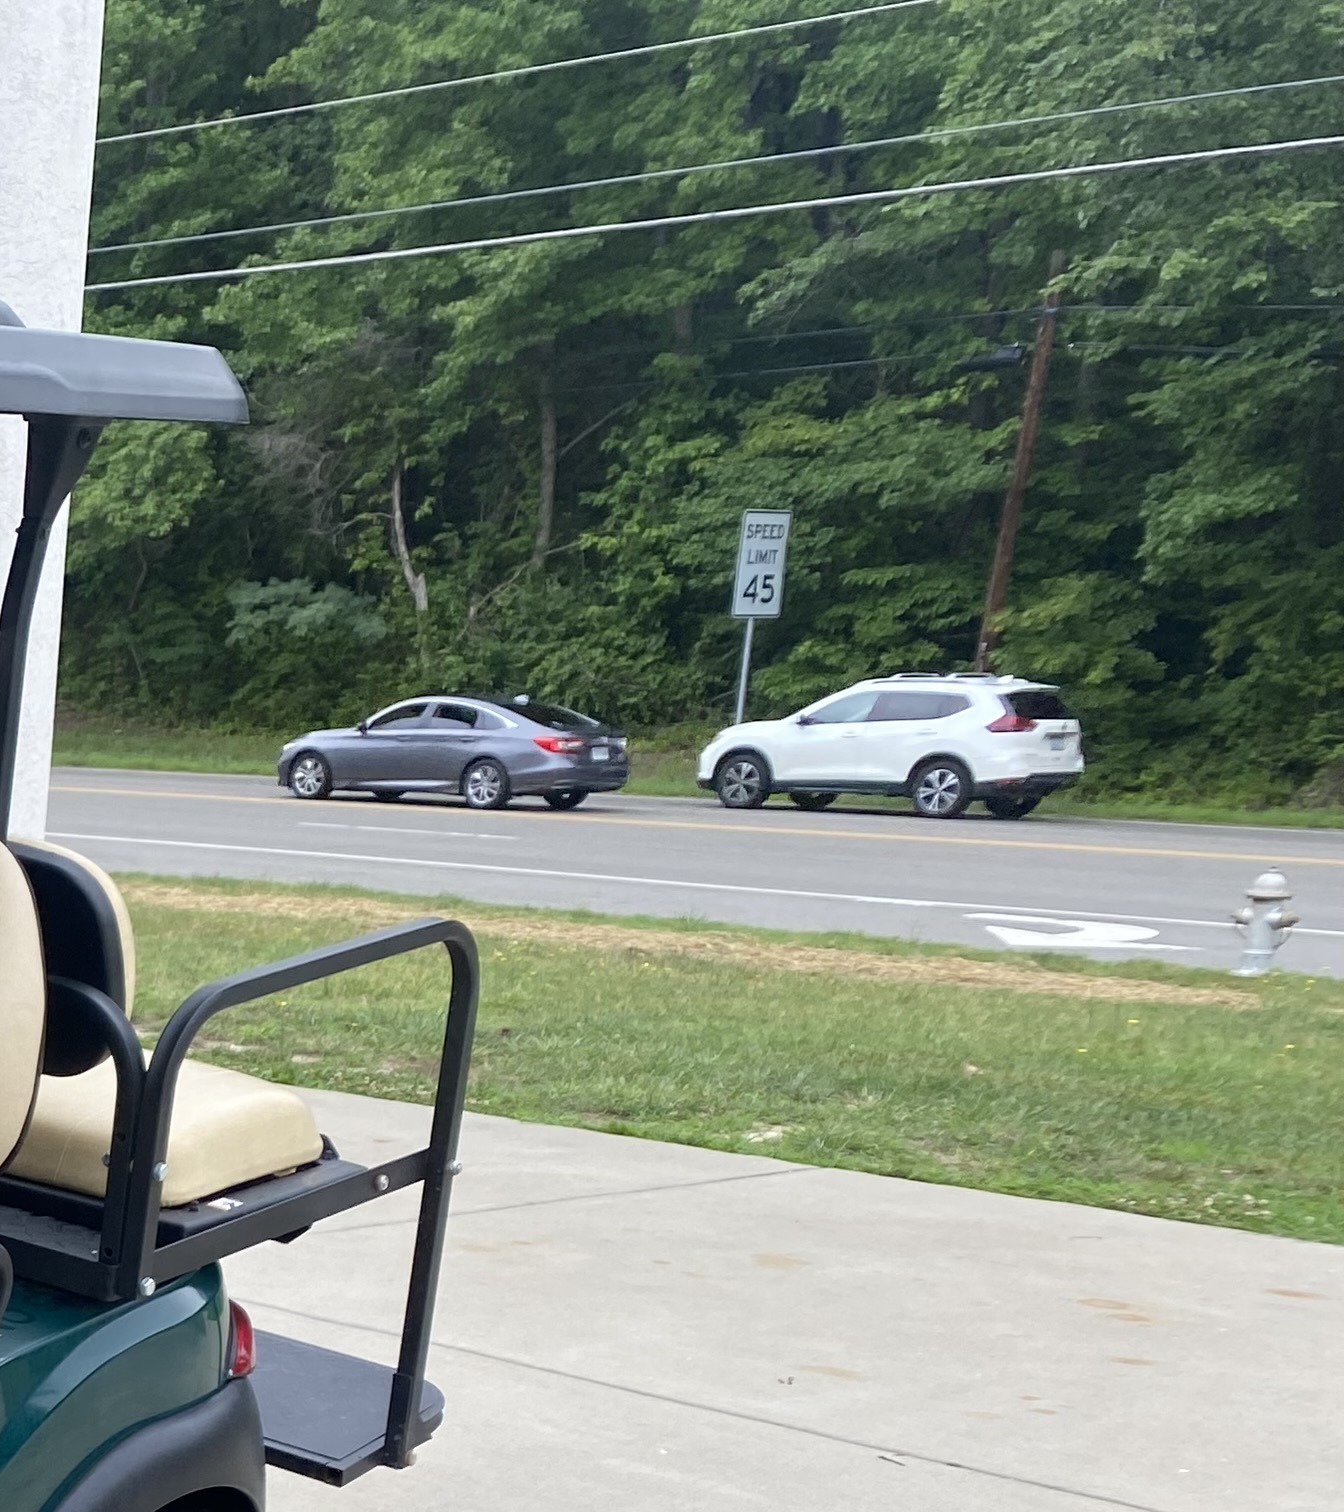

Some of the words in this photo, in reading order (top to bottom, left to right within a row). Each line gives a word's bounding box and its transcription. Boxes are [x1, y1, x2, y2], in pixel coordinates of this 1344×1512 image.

[746, 523, 785, 540] SPEED
[746, 549, 779, 565] LIMIT
[742, 573, 775, 604] 45
